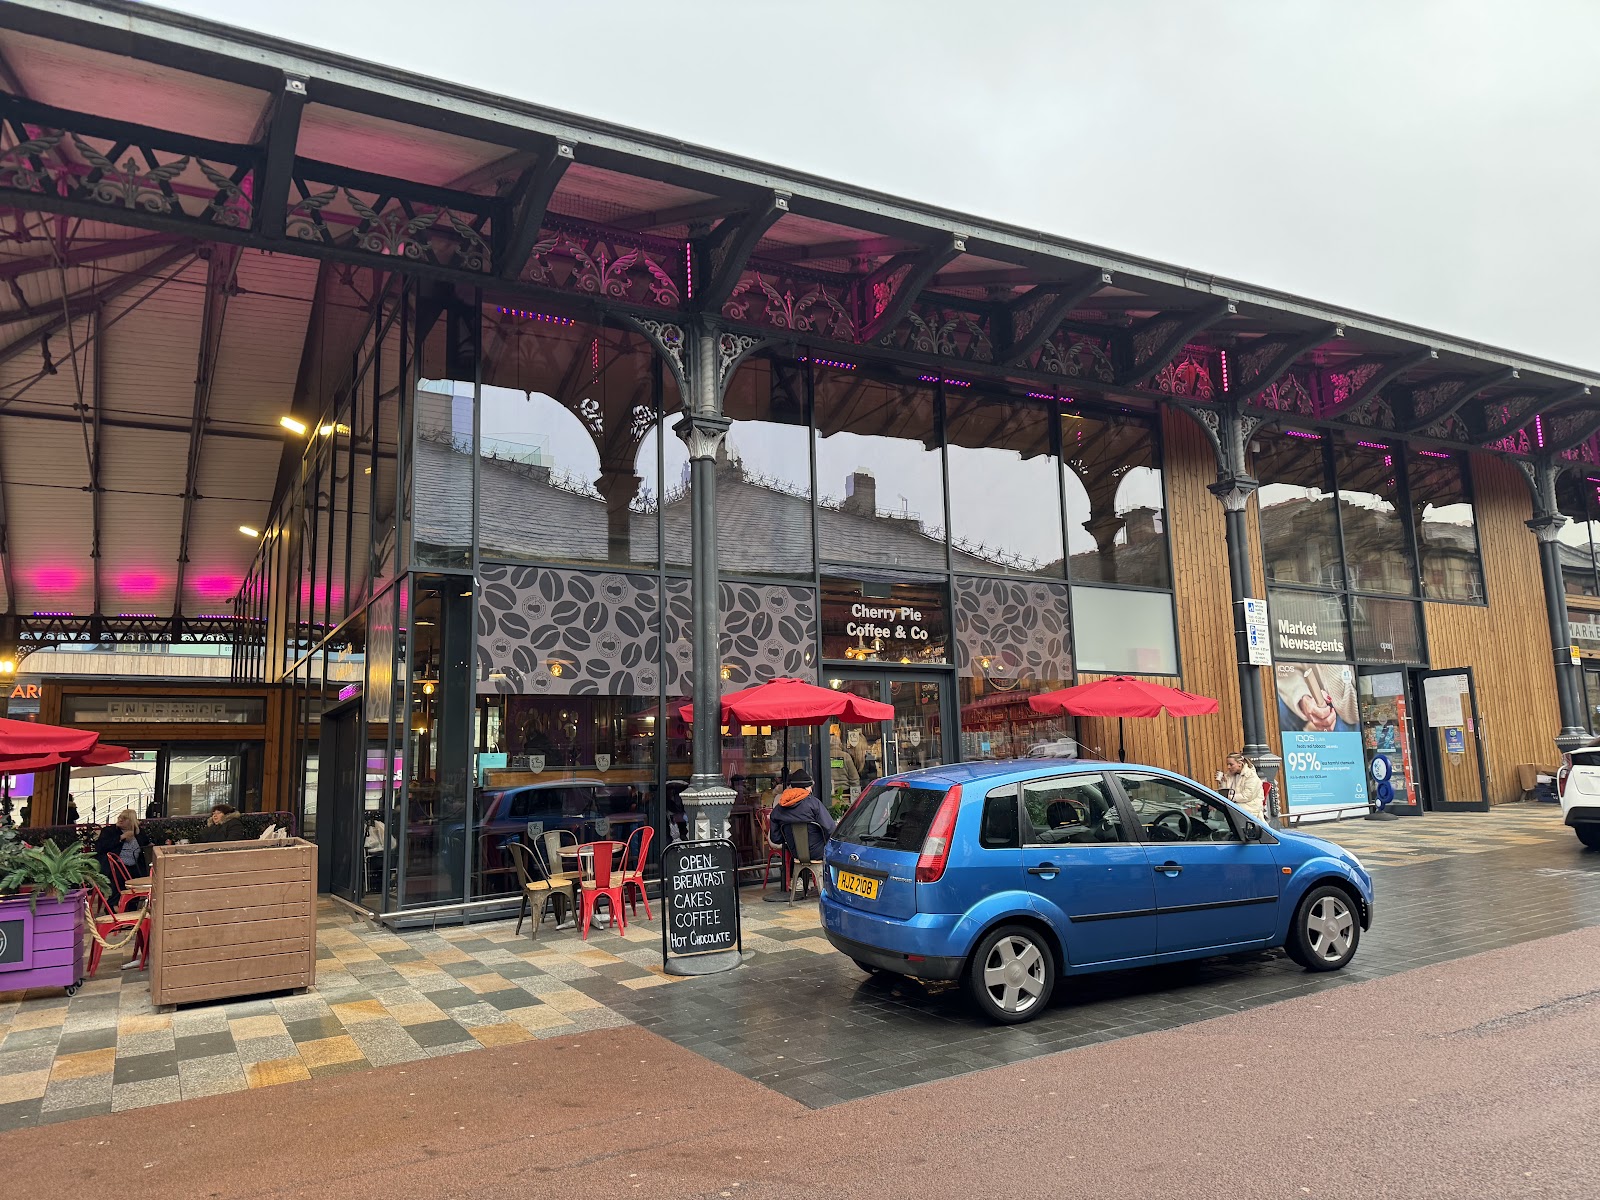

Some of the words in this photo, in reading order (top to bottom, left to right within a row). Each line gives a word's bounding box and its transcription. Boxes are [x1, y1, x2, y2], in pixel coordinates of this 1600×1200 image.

[851, 603, 896, 622] Cherry
[900, 606, 922, 622] Pie
[846, 621, 891, 638] Coffee
[895, 624, 907, 639] &
[910, 625, 928, 640] Co
[1277, 619, 1318, 636] Market
[1279, 634, 1345, 654] Newsagents
[1277, 665, 1295, 673] IQOS
[110, 703, 223, 714] ENTRANCE
[1295, 734, 1315, 742] IQOS
[1287, 751, 1321, 772] 95%
[680, 853, 712, 870] OPEN
[673, 871, 726, 891] BREAKFAST
[674, 891, 713, 909] CAKES
[675, 909, 721, 928] COFFEE
